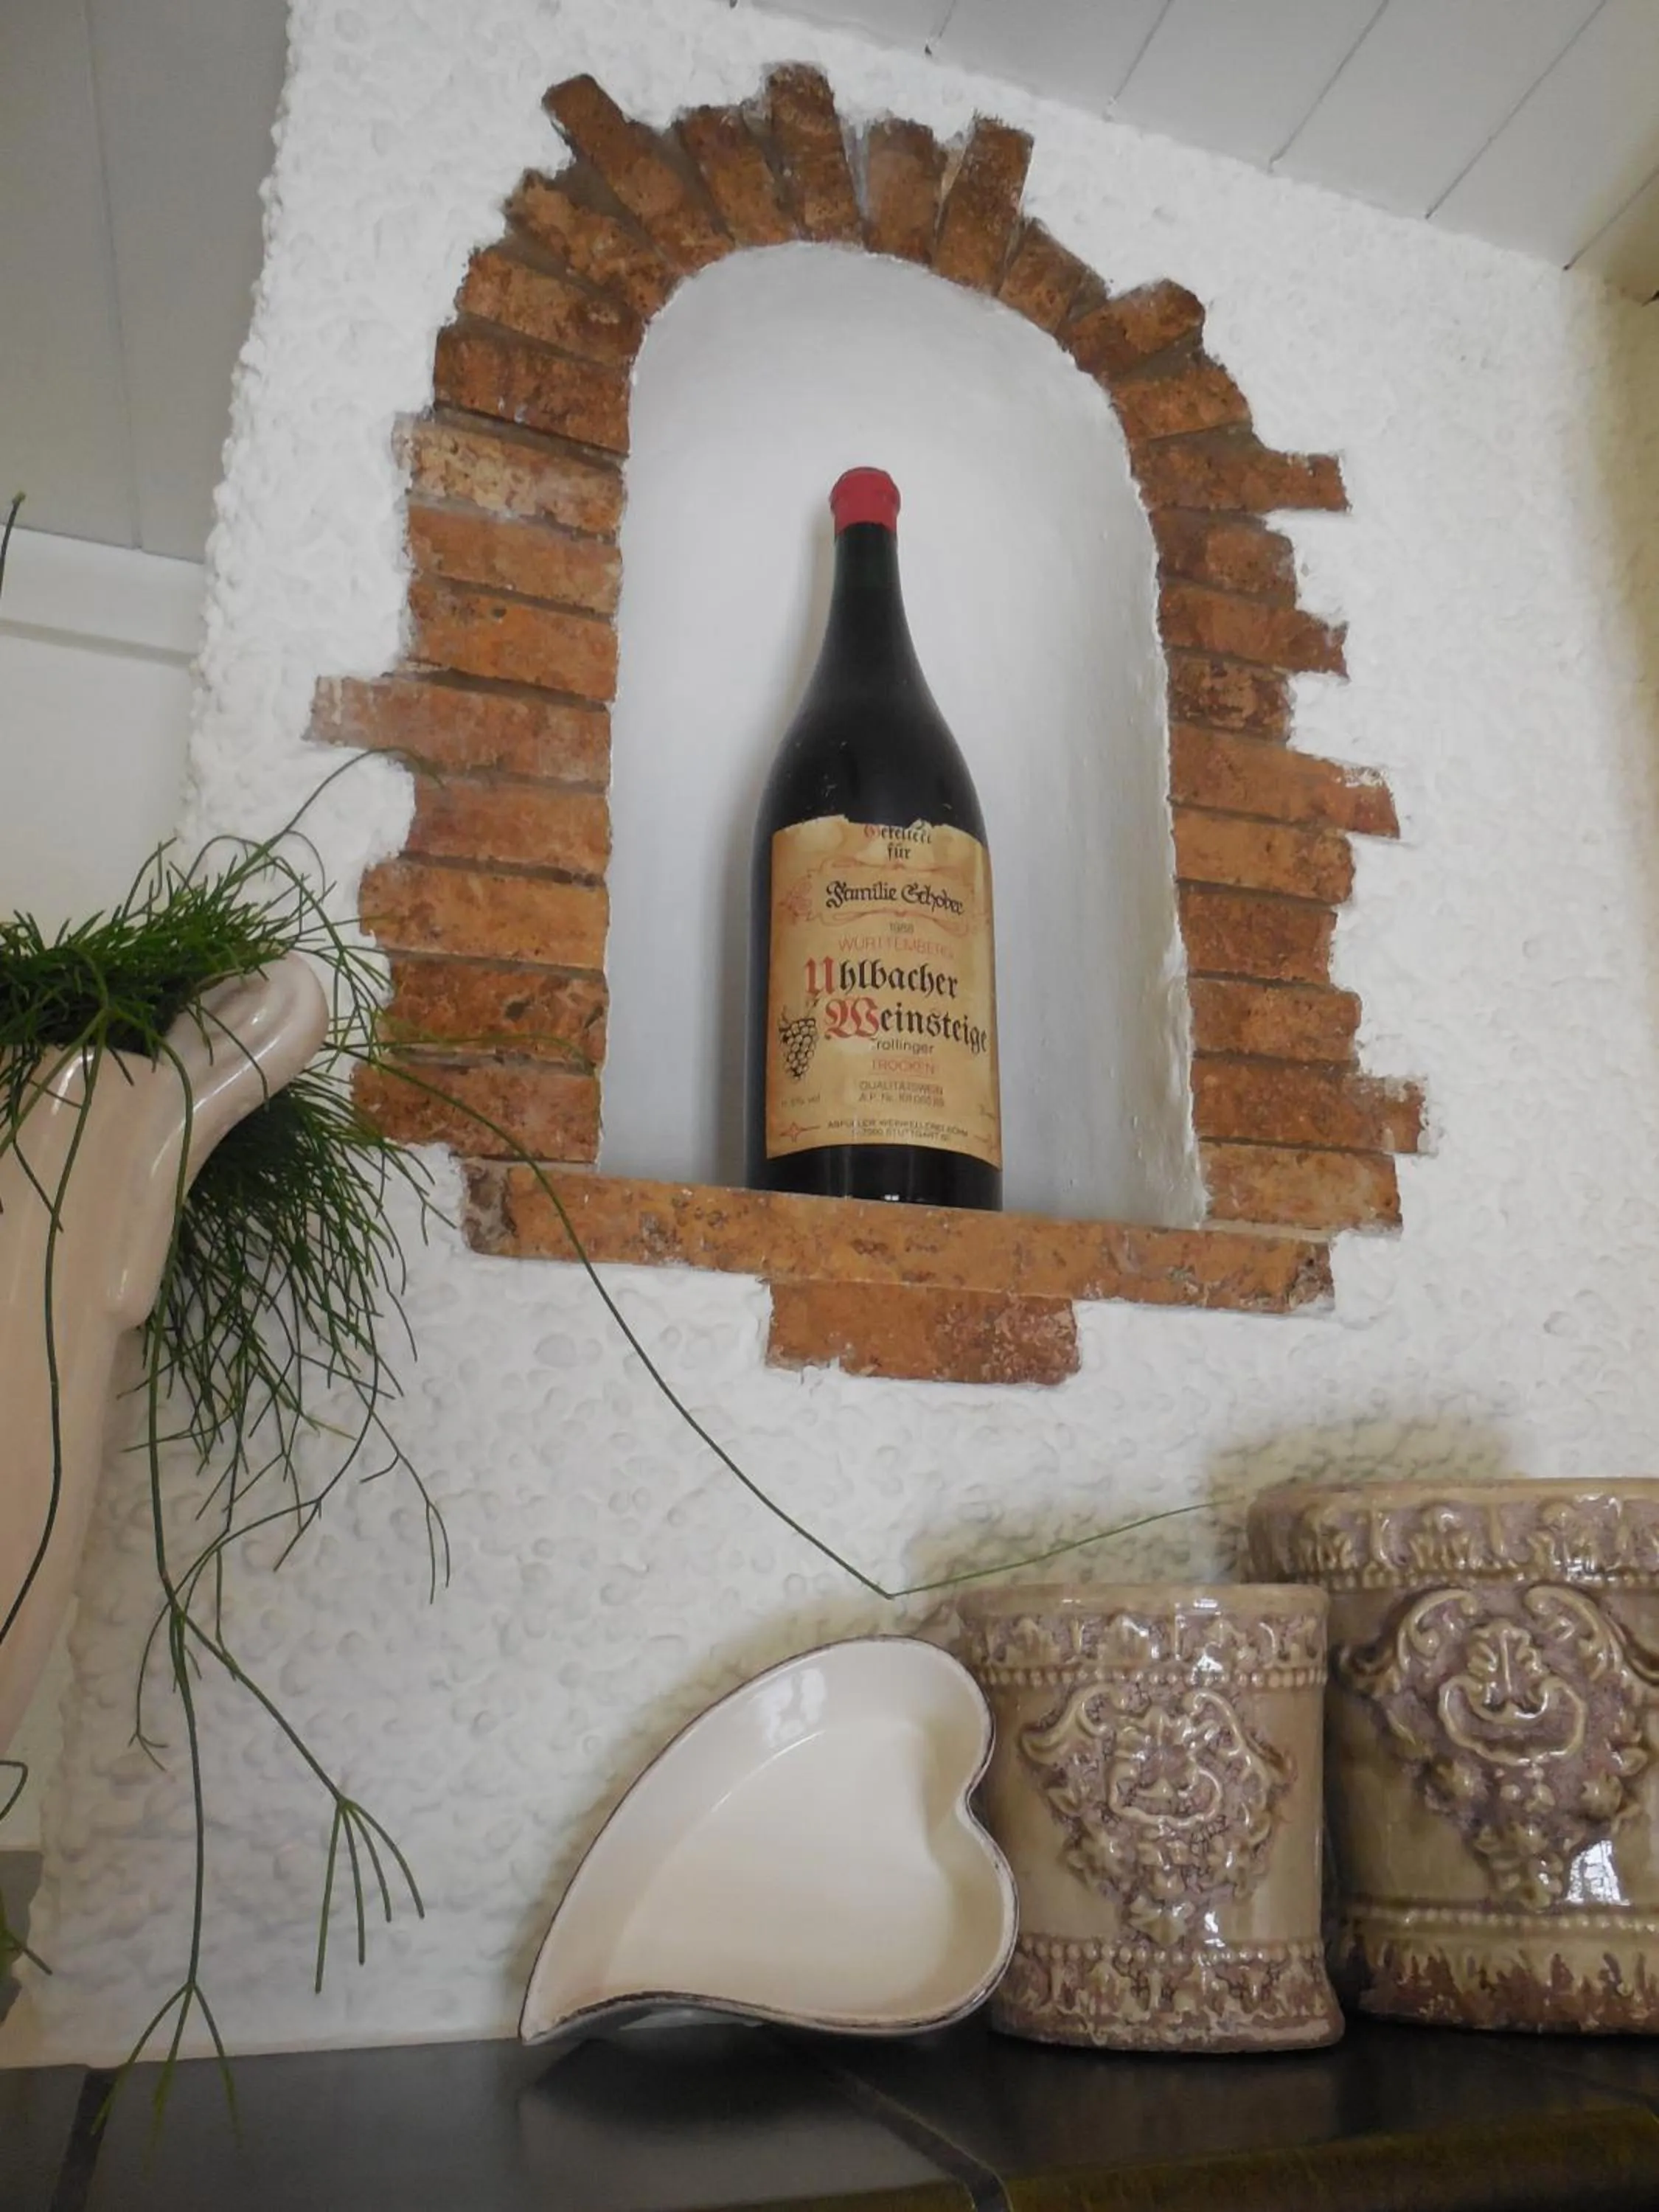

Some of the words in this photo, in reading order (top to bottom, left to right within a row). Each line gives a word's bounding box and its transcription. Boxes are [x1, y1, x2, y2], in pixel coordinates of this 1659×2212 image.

[887, 842, 911, 861] für
[825, 880, 897, 908] Familie
[804, 956, 959, 998] Uhlbacher
[824, 996, 989, 1054] Weinsteige
[872, 1038, 934, 1055] rollinger
